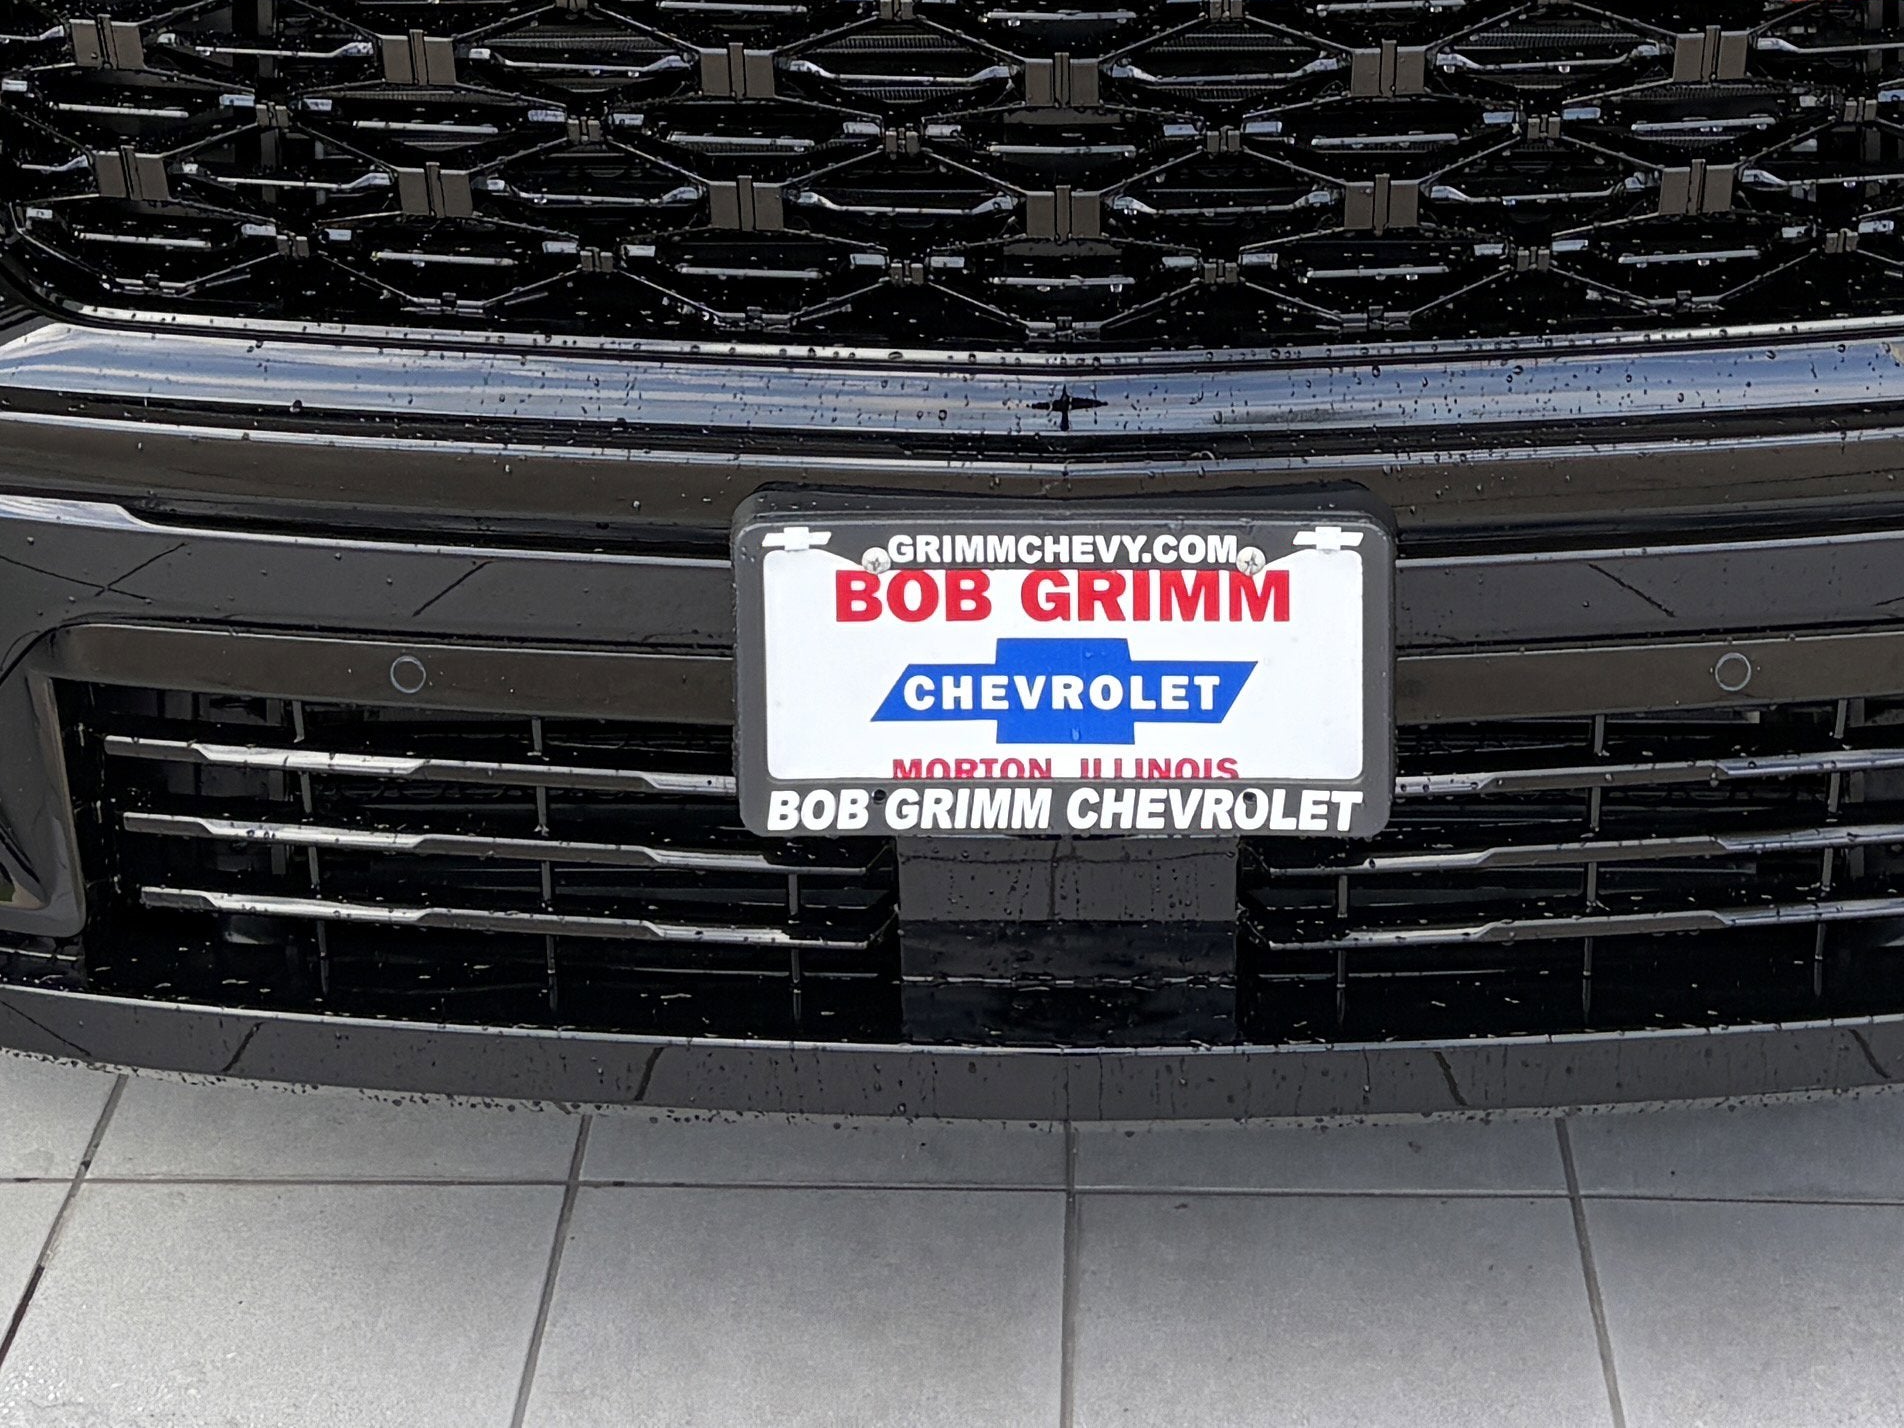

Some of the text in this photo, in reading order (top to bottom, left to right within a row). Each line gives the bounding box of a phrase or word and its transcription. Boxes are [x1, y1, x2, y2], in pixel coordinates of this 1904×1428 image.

[887, 534, 1238, 564] GRIMMCHEVY.COM
[836, 569, 1290, 622] BOB GRIMM
[903, 674, 1221, 711] CHEVROLET
[766, 787, 1364, 832] BOB GRIMM CHEVROLET
